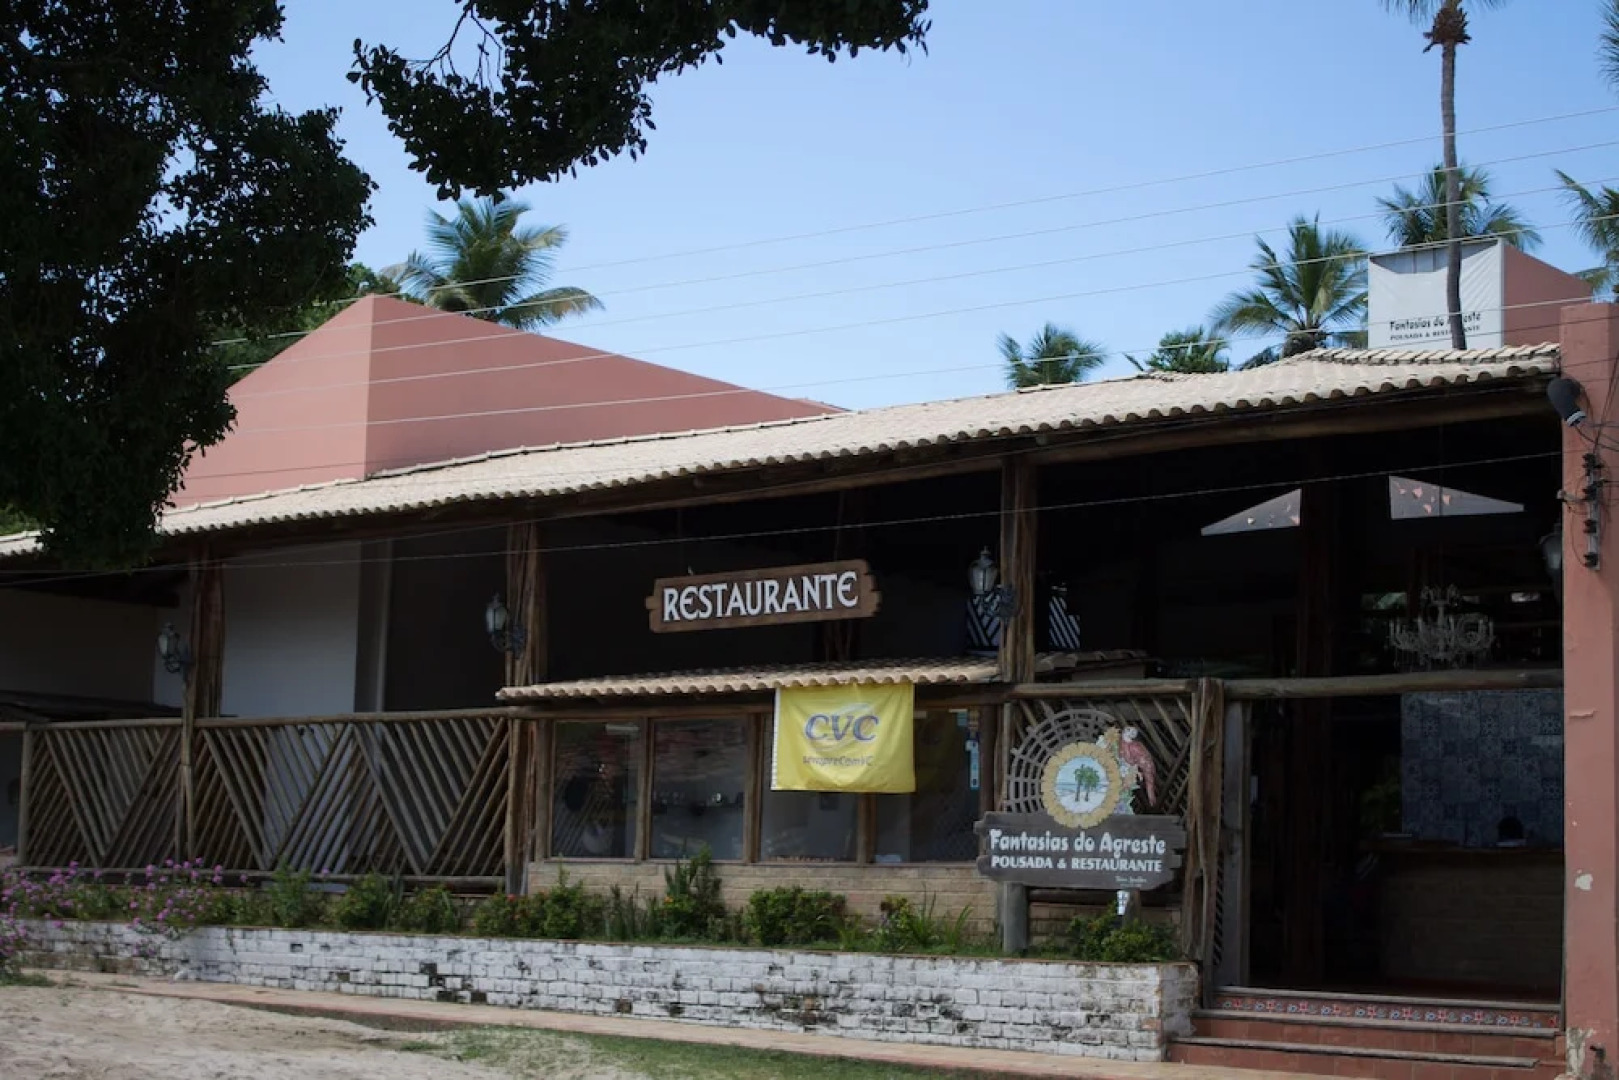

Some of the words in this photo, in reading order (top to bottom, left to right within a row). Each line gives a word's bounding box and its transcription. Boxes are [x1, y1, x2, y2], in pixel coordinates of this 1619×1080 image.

[663, 570, 859, 622] RESTAURANTE
[804, 713, 880, 741] CVC
[990, 829, 1069, 851] Fantasias
[1074, 831, 1095, 852] do
[1100, 832, 1166, 858] Agreste
[991, 855, 1053, 869] POUSADA
[1057, 858, 1067, 869] &
[1071, 857, 1163, 872] RESTAURANTE
